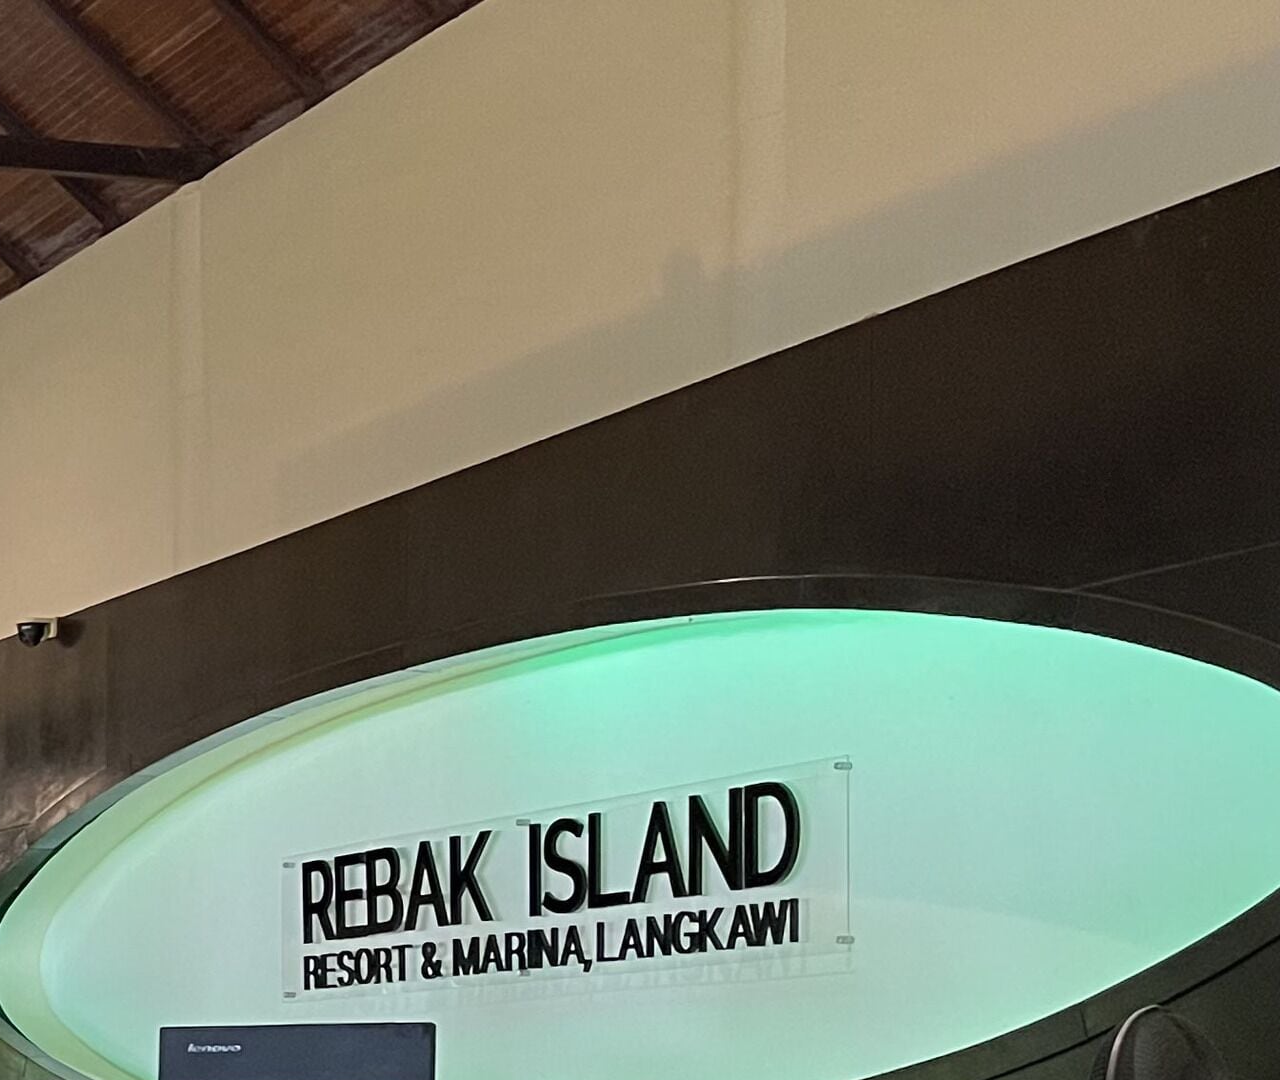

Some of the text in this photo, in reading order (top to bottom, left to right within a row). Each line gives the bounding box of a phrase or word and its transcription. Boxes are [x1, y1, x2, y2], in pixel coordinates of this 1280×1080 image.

[303, 781, 801, 943] REBAK ISLAND
[303, 897, 799, 991] RESORT & MARINA, LANGKAWI
